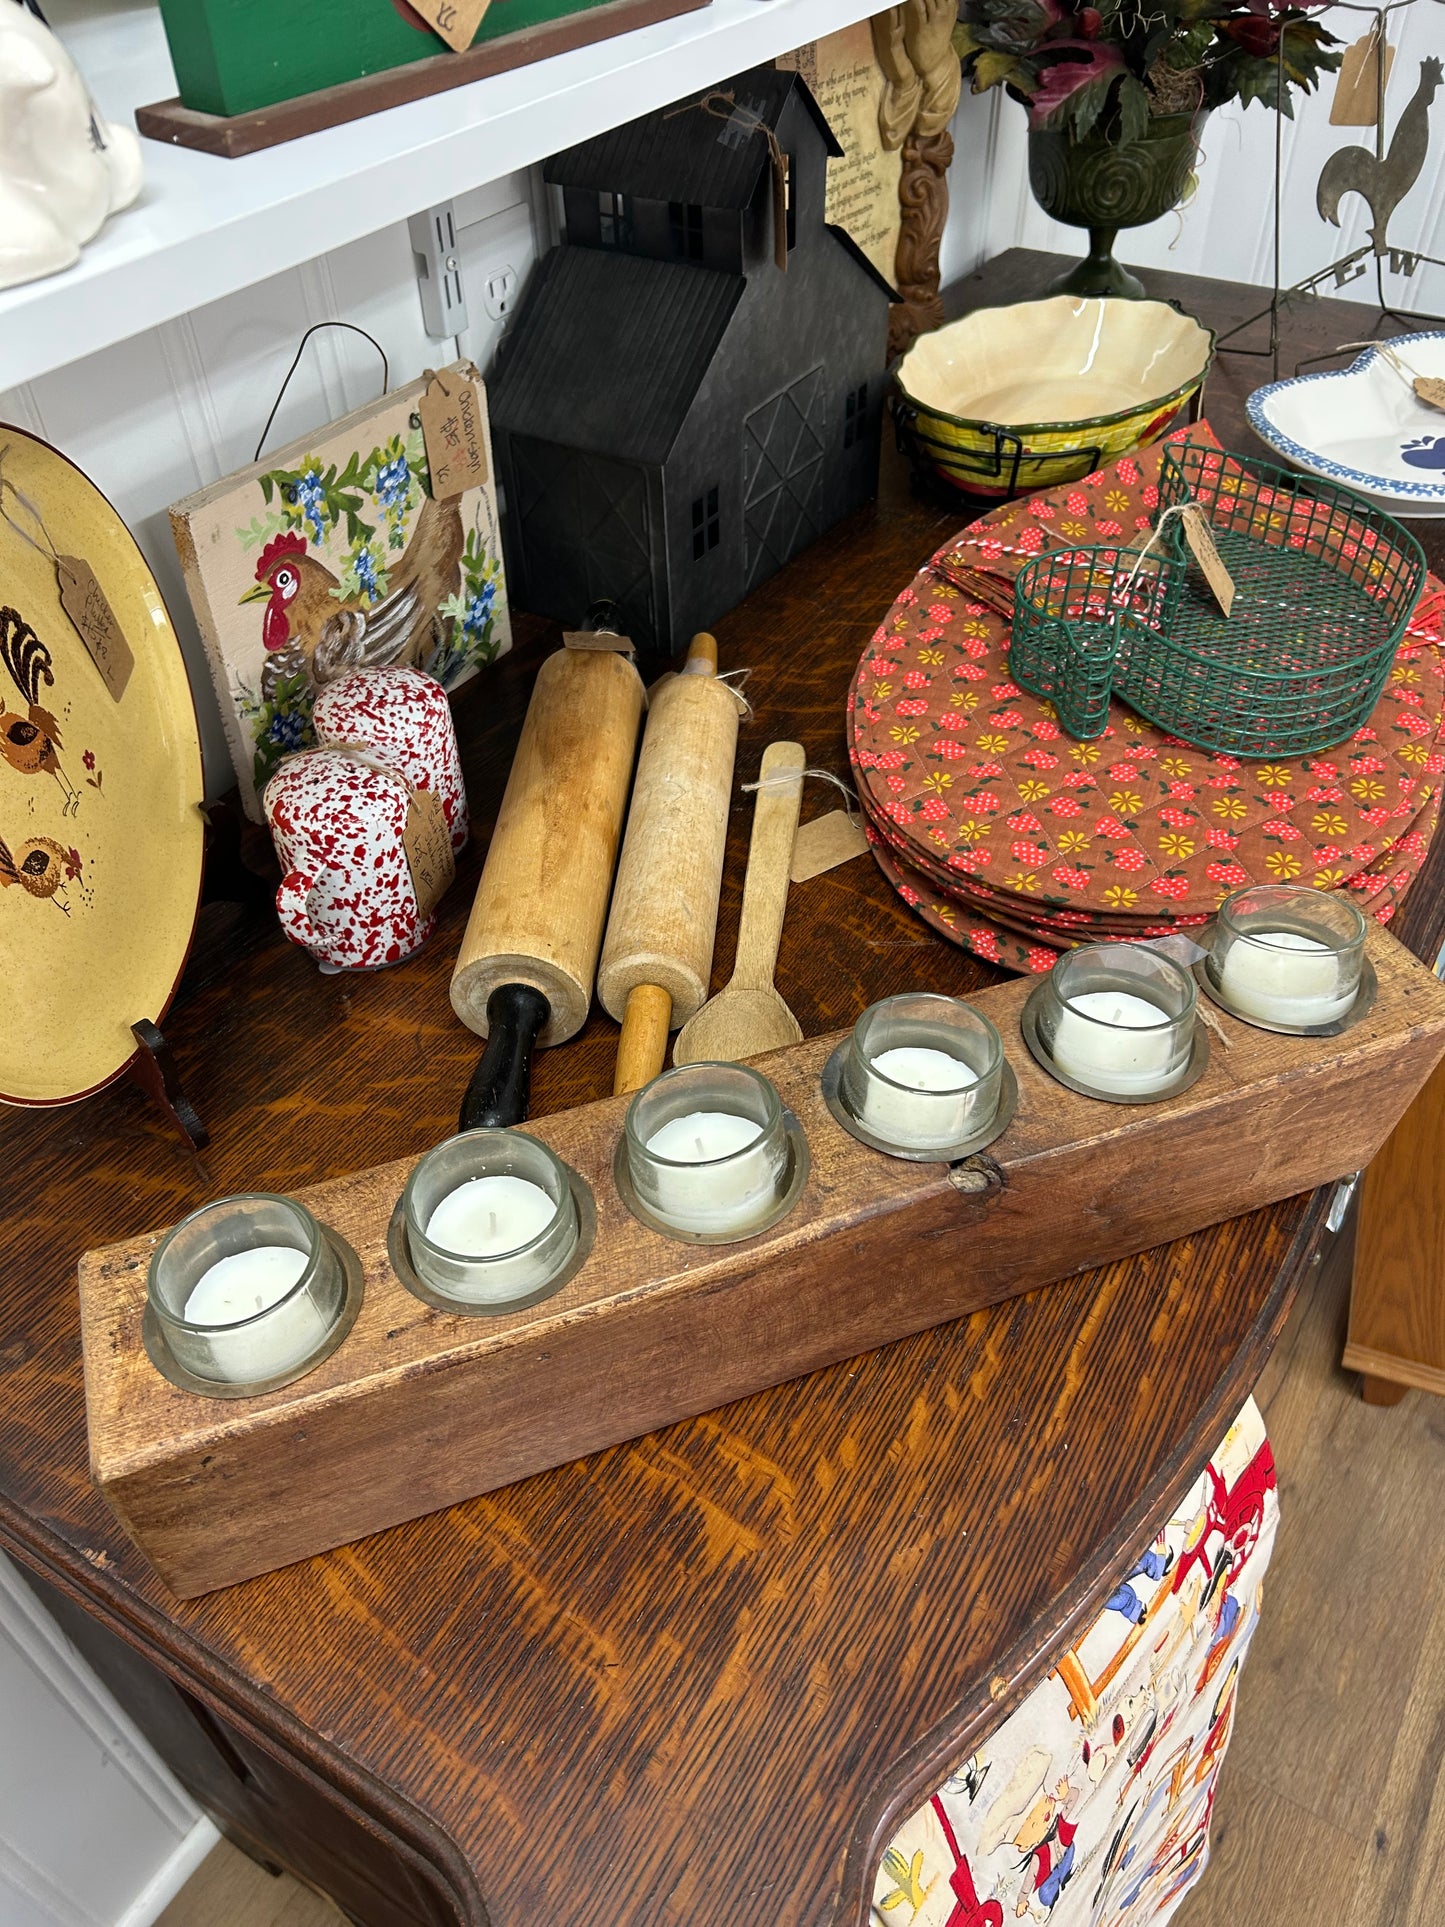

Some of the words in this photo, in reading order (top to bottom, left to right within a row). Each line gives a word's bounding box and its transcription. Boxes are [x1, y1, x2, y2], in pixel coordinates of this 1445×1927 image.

[1333, 251, 1366, 289] E
[1390, 249, 1423, 277] W
[458, 390, 476, 442] Chicken
